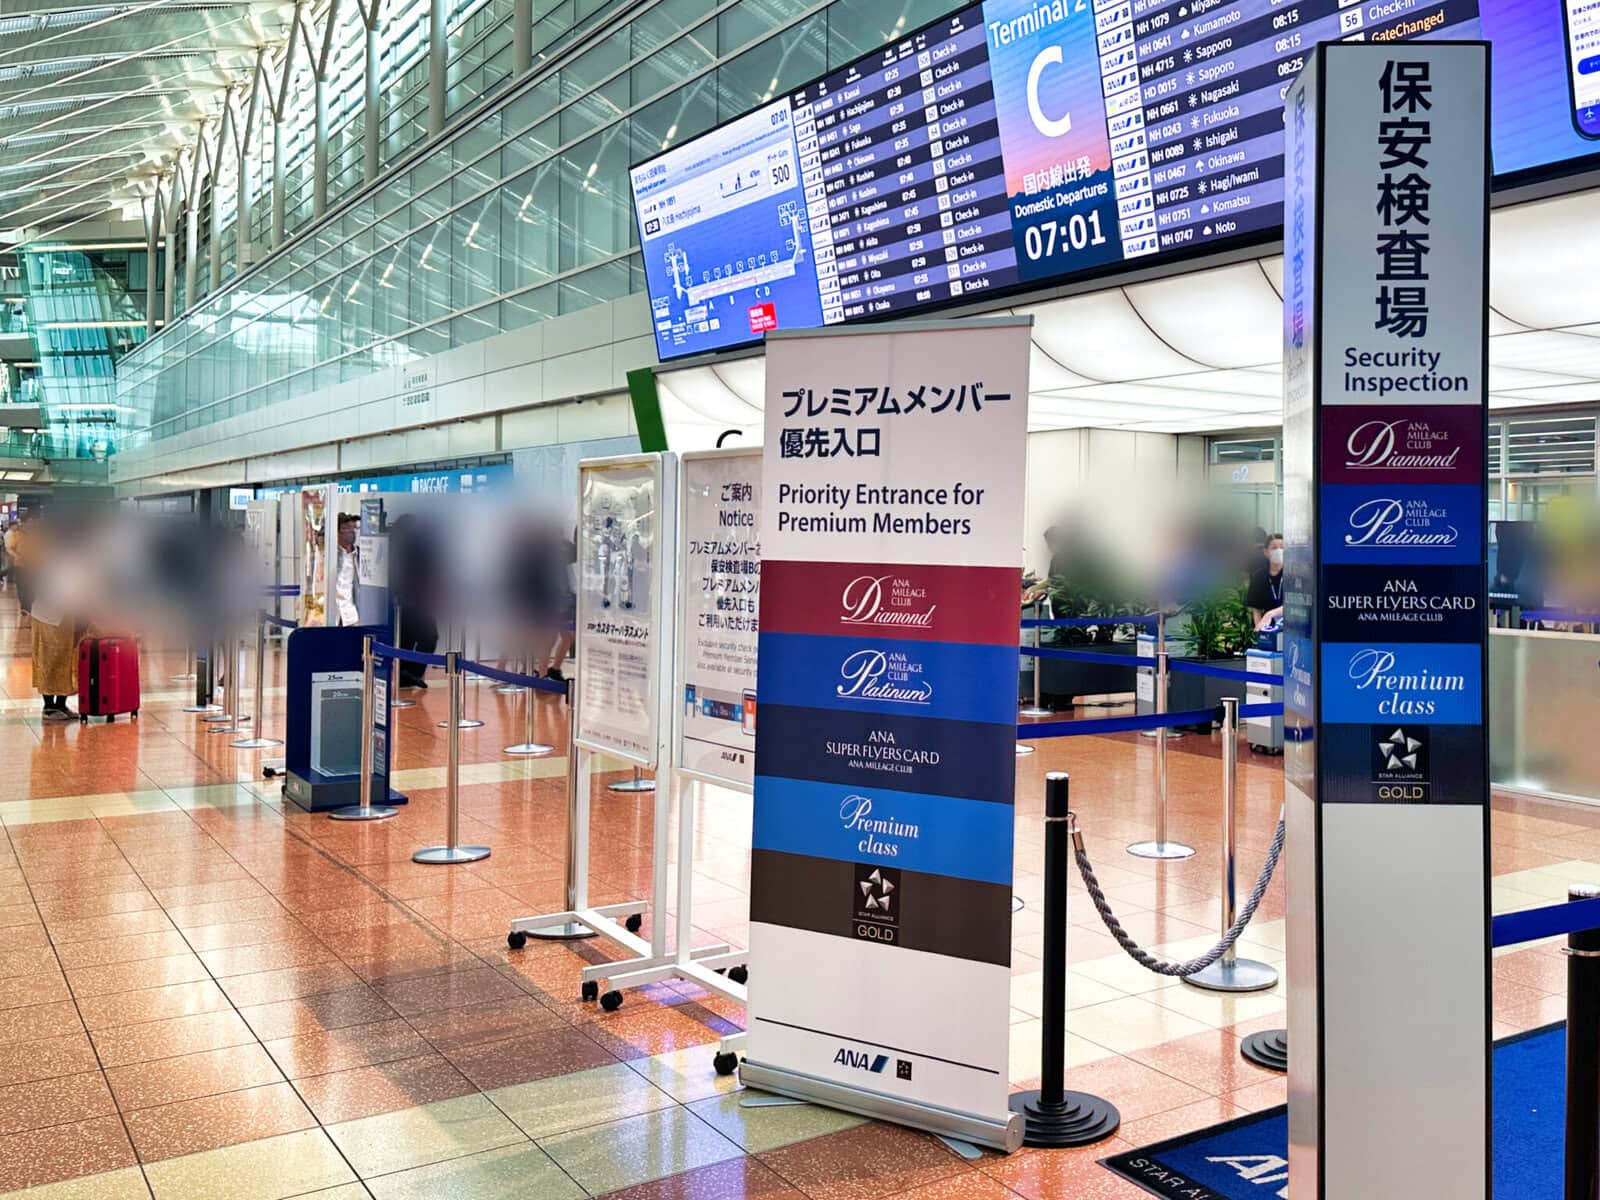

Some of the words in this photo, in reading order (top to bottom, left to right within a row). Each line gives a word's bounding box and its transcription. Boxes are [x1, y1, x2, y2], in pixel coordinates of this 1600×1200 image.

[989, 0, 1068, 48] Terminal
[1136, 22, 1149, 35] NH
[1151, 13, 1170, 30] 1079
[1345, 13, 1358, 28] 56
[1369, 0, 1416, 20] Check-in
[1139, 43, 1151, 56] NH
[1193, 10, 1240, 36] Kumamoto
[933, 44, 957, 60] Check-in
[1142, 65, 1154, 78] NH
[1155, 56, 1174, 72] 4715
[1196, 38, 1232, 58] Sapporo
[1273, 9, 1299, 29] 08:15
[935, 61, 959, 78] Check-in
[1144, 87, 1156, 99] HD
[1158, 79, 1177, 95] 0015
[1198, 61, 1234, 81] Sapporo
[1276, 33, 1301, 53] 08:15
[938, 80, 962, 96] Check-in
[1026, 45, 1072, 138] C
[1146, 108, 1159, 120] NH
[1201, 80, 1240, 104] Nagasaki
[1278, 57, 1304, 76] 08:25
[940, 98, 964, 114] Check-in
[943, 118, 967, 132] Check-in
[1149, 129, 1161, 141] NH
[1163, 123, 1182, 138] 0243
[1203, 105, 1240, 125] Fukuoka
[945, 135, 969, 150] Check-in
[1152, 150, 1164, 163] NH
[1205, 127, 1238, 147] Ishigaki
[948, 154, 972, 168] Check-in
[1154, 172, 1166, 184] NH
[1208, 151, 1246, 169] Okinawa
[772, 163, 790, 185] 500
[950, 171, 974, 186] Check-in
[1023, 155, 1092, 196] 国内線出発
[953, 189, 977, 204] Check-in
[1156, 193, 1168, 205] NH
[1170, 186, 1189, 201] 0725
[1210, 168, 1259, 192] Hagi/Iwami
[1014, 193, 1055, 218] Domestic
[1056, 181, 1108, 206] Departures
[1375, 60, 1432, 338] 保安検査場
[955, 207, 979, 221] Check-in
[1159, 214, 1171, 225] NH
[1172, 208, 1191, 222] 0751
[1212, 195, 1251, 212] Komatsu
[958, 225, 982, 238] Check-in
[1024, 209, 1106, 260] 07:01
[1161, 234, 1174, 246] NH
[1174, 229, 1194, 242] 0747
[1216, 220, 1237, 234] Noto
[960, 243, 984, 256] Check-in
[962, 261, 987, 273] Check-in
[965, 278, 989, 291] Check-in
[1344, 348, 1441, 372] Security
[1345, 372, 1468, 396] Inspection
[782, 382, 1011, 418] プレミアムメンバー
[1407, 432, 1448, 440] MILEAGE
[1408, 423, 1429, 431] ANA
[780, 428, 881, 458] 優先入口
[1345, 419, 1460, 468] Diamond
[1406, 441, 1432, 449] CLUB
[721, 482, 752, 501] ご案内
[778, 484, 850, 509] Priority
[856, 484, 948, 505] Entrance
[953, 483, 984, 504] for
[1405, 509, 1447, 518] MILEAGE
[1406, 500, 1428, 508] ANA
[719, 510, 753, 526] Notice
[778, 512, 866, 533] Premium
[873, 512, 971, 535] Members
[1345, 498, 1458, 545] Platinum
[1405, 518, 1430, 527] CLUB
[892, 579, 910, 587] ANA
[892, 588, 926, 598] MILEAGE
[1383, 579, 1418, 593] ANA
[840, 575, 936, 626] Diamond
[891, 598, 911, 606] CLUB
[1328, 596, 1374, 609] SUPER
[1375, 596, 1427, 610] FLYERS
[1430, 596, 1475, 610] CARD
[1358, 613, 1378, 621] ANA
[1380, 613, 1418, 621] MILEAGE
[1420, 613, 1443, 622] CLUB
[889, 652, 906, 662] ANA
[837, 649, 932, 701] Platinum
[888, 662, 923, 673] MILEAGE
[888, 672, 908, 681] CLUB
[1348, 648, 1464, 691] Premium
[1378, 694, 1435, 714] class
[869, 730, 895, 744] ANA
[826, 741, 861, 756] SUPER
[862, 745, 902, 760] FLYERS
[903, 750, 940, 764] CARD
[849, 760, 863, 769] ANA
[865, 762, 894, 772] MILEAGE
[895, 765, 913, 774] CLUB
[1378, 786, 1424, 799] GOLD
[840, 794, 919, 838] Premium
[859, 835, 898, 856] class
[857, 926, 894, 941] GOLD
[834, 1048, 870, 1071] ANA
[1130, 1158, 1184, 1188] STAR
